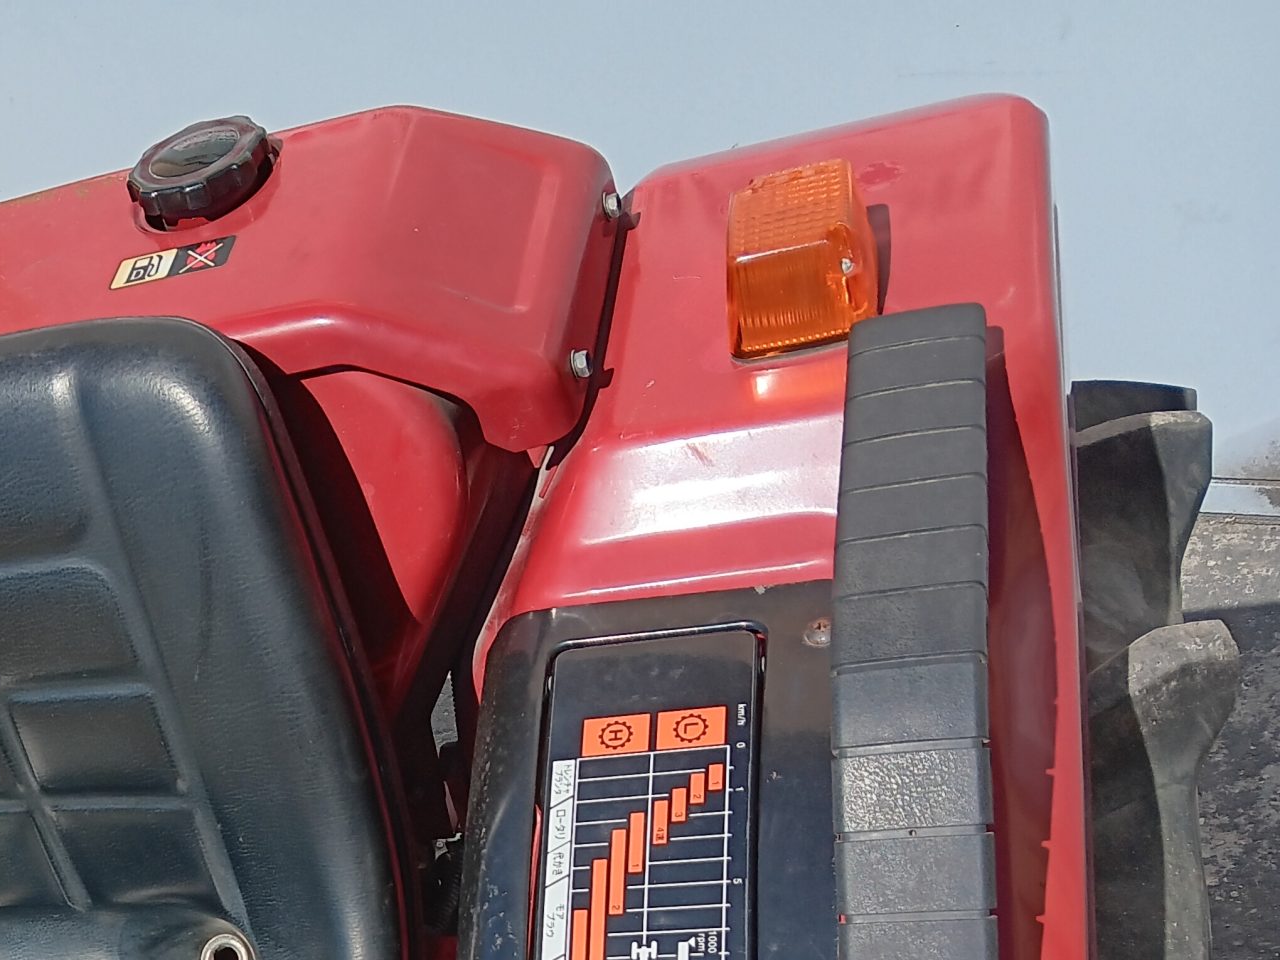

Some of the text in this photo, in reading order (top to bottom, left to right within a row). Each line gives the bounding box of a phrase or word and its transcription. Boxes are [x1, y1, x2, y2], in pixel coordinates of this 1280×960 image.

[130, 269, 144, 281] D
[736, 703, 746, 726] km/h
[609, 730, 624, 742] H
[684, 722, 698, 735] L
[736, 741, 745, 749] 0
[563, 763, 572, 794] トレンチャ
[555, 808, 567, 840] ロータリ
[656, 826, 665, 842] 4速
[552, 851, 565, 877] 代かき
[733, 877, 742, 885] 5
[555, 903, 565, 920] モア
[696, 932, 706, 952] rpm
[707, 930, 717, 953] 1000
